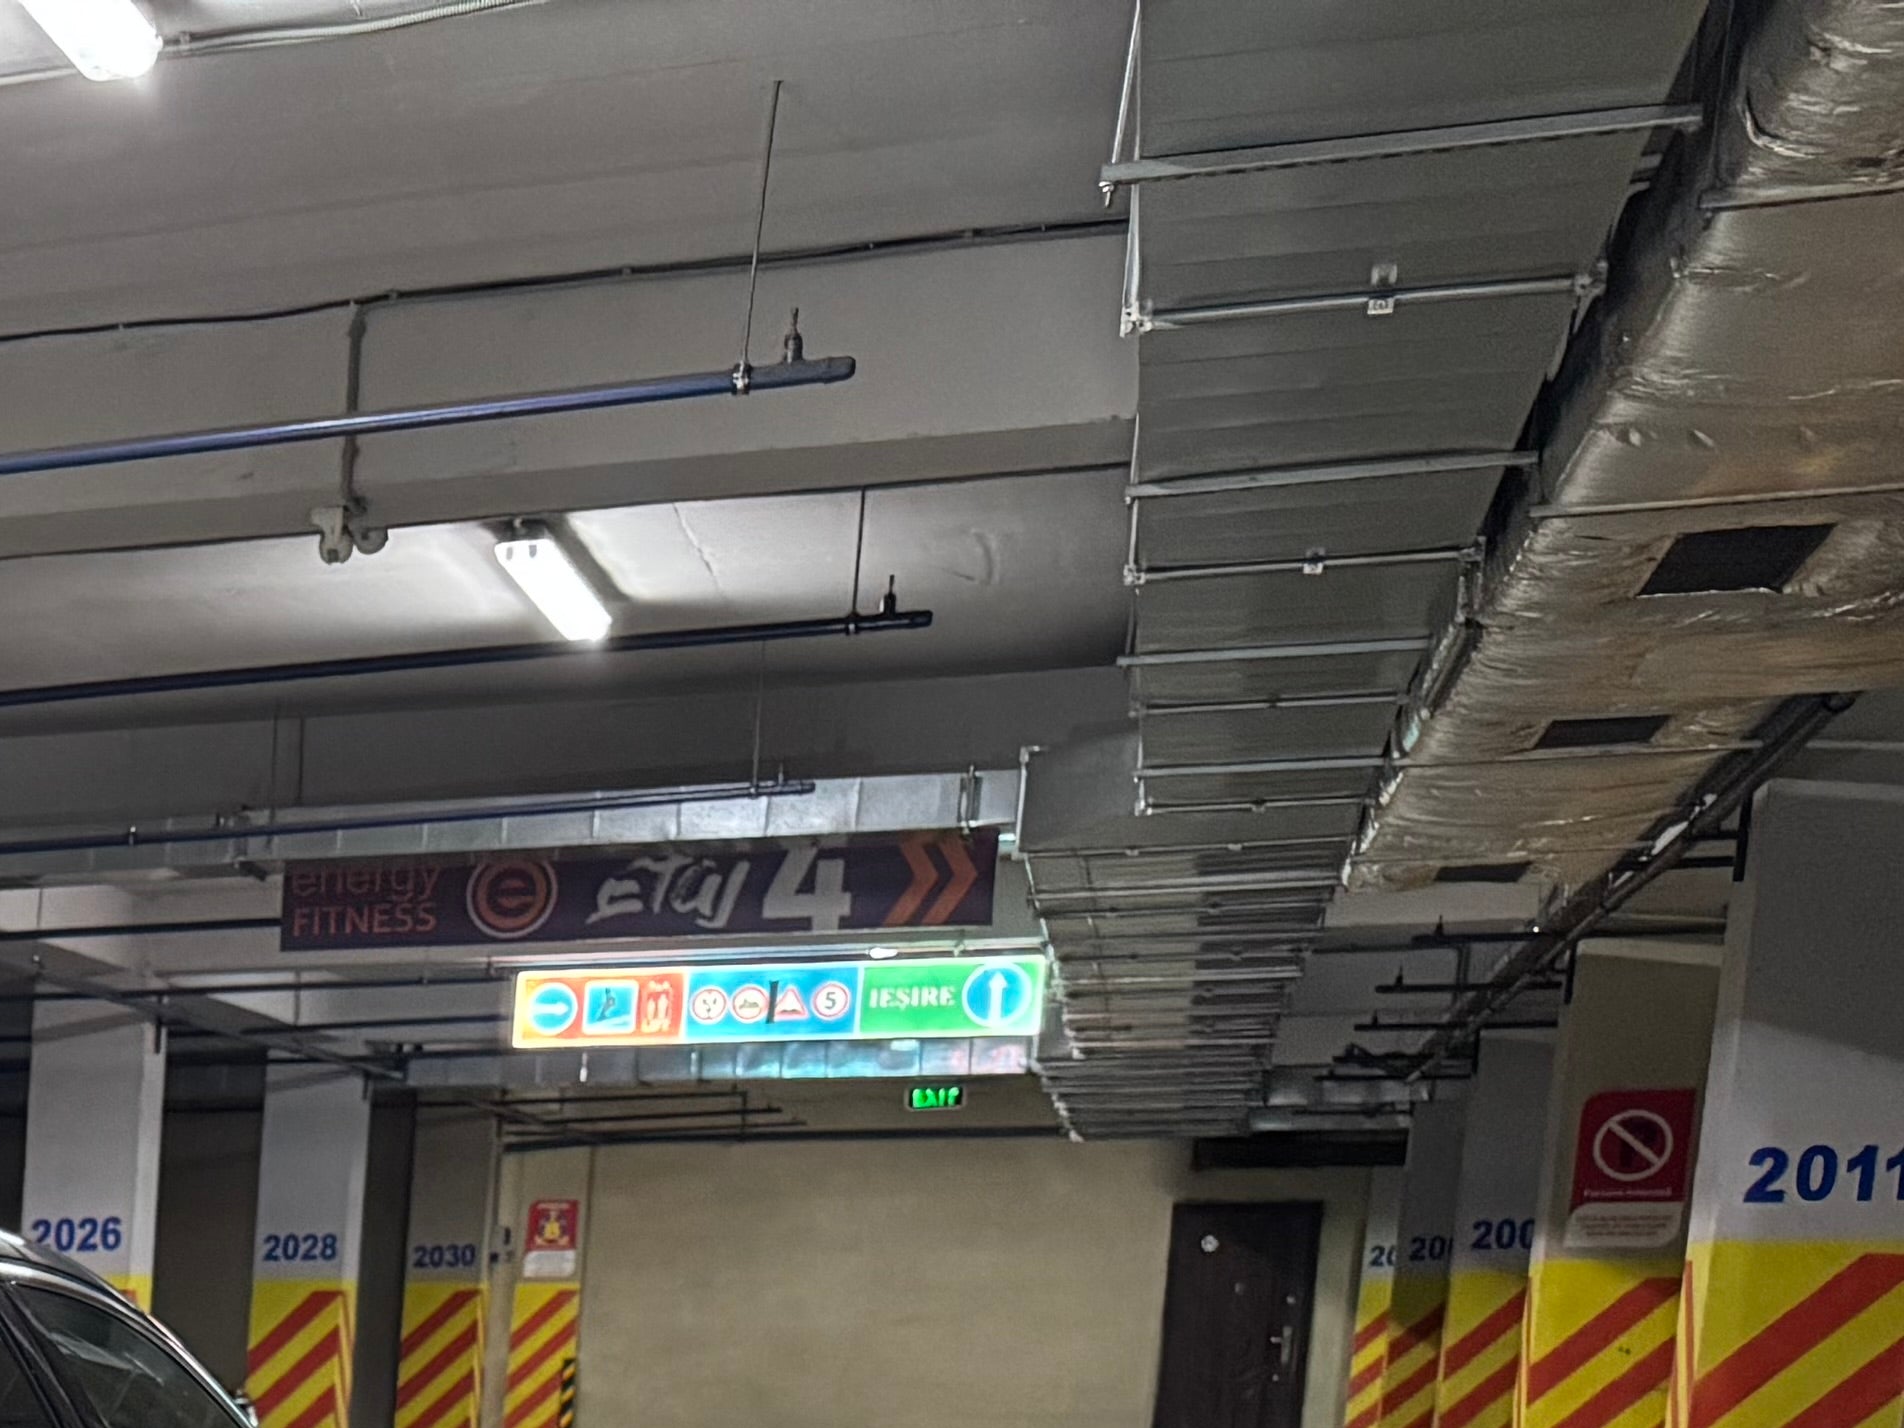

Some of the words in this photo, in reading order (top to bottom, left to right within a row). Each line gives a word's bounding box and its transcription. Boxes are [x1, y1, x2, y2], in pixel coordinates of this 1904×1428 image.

[293, 863, 442, 900] energy
[762, 840, 852, 931] 4
[293, 902, 439, 937] FITNESS
[31, 1216, 122, 1253] 2026
[263, 1233, 338, 1262] 2028
[1409, 1236, 1453, 1262] 20
[413, 1244, 476, 1268] 2030
